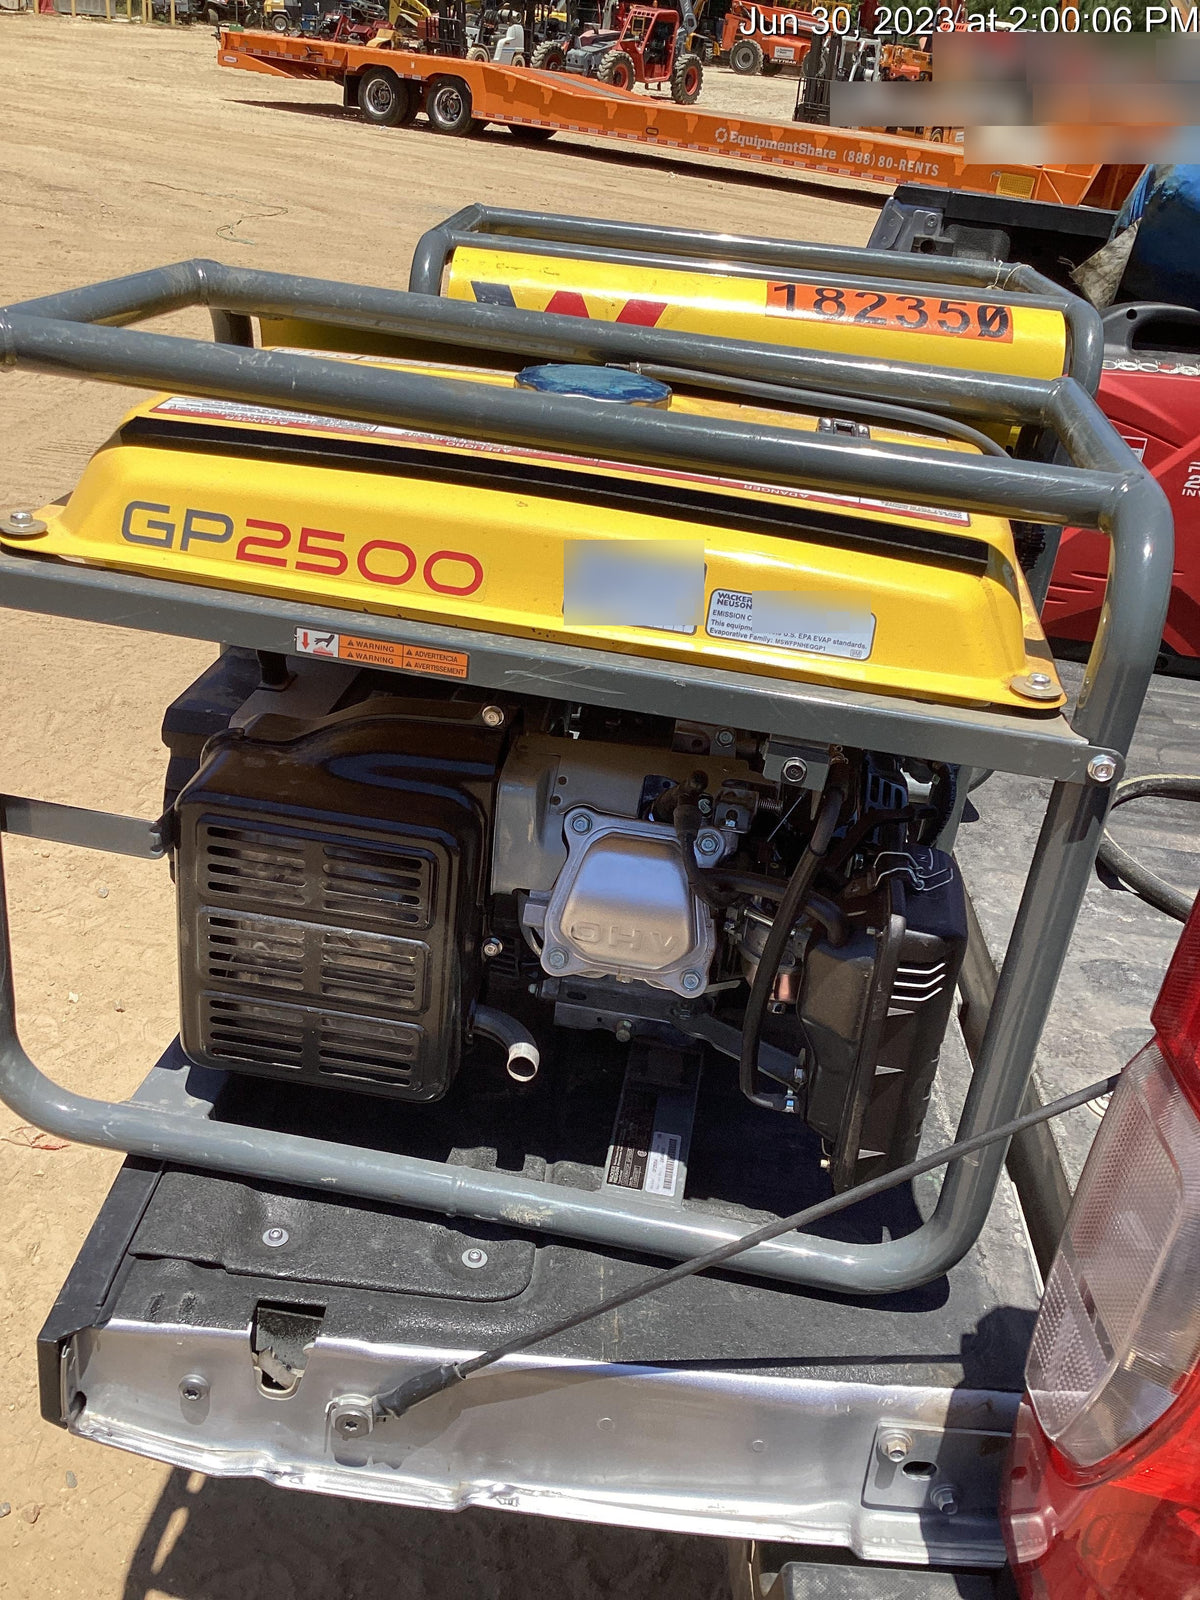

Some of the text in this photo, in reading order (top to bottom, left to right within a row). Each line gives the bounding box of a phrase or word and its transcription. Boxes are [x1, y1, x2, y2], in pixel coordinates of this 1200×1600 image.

[729, 132, 939, 177] EquipmentShare (888) 80-RENTS
[773, 283, 1009, 338] 182350
[121, 500, 484, 596] GP2500
[717, 592, 752, 603] WACKER
[716, 599, 752, 610] NEUSON
[712, 609, 746, 620] EMISSION
[711, 619, 725, 627] This
[709, 627, 748, 640] Evaporative
[749, 633, 774, 644] Family:
[355, 640, 395, 653] WARNING
[813, 635, 832, 645] EVAP
[832, 639, 868, 650] standards.
[355, 652, 394, 665] WARNING
[414, 650, 458, 663] ADVERTENCIA
[413, 662, 465, 676] AVERTISSEMENT
[570, 921, 677, 952] OHV
